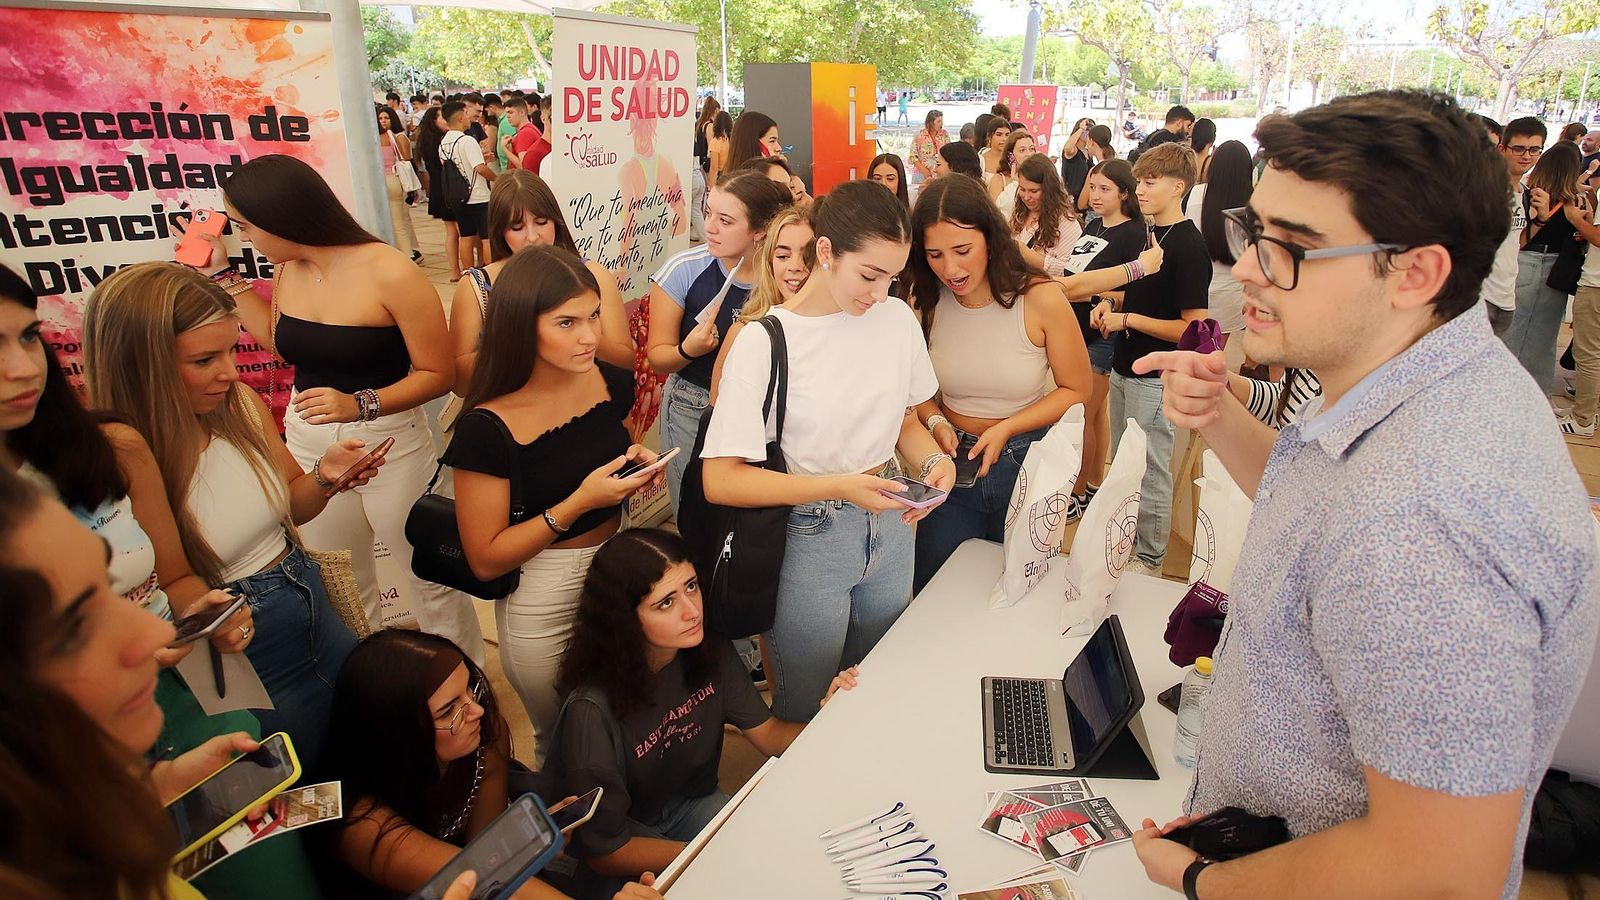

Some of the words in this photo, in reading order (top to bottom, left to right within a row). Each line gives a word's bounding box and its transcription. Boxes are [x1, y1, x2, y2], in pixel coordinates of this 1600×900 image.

[577, 43, 680, 82] UNIDAD
[0, 101, 234, 141] rección
[248, 105, 311, 142] de
[563, 87, 602, 123] DE
[610, 86, 690, 122] SALUD
[628, 184, 682, 212] medicina
[618, 207, 668, 243] alimento
[672, 213, 681, 239] y
[1090, 799, 1102, 809] DE
